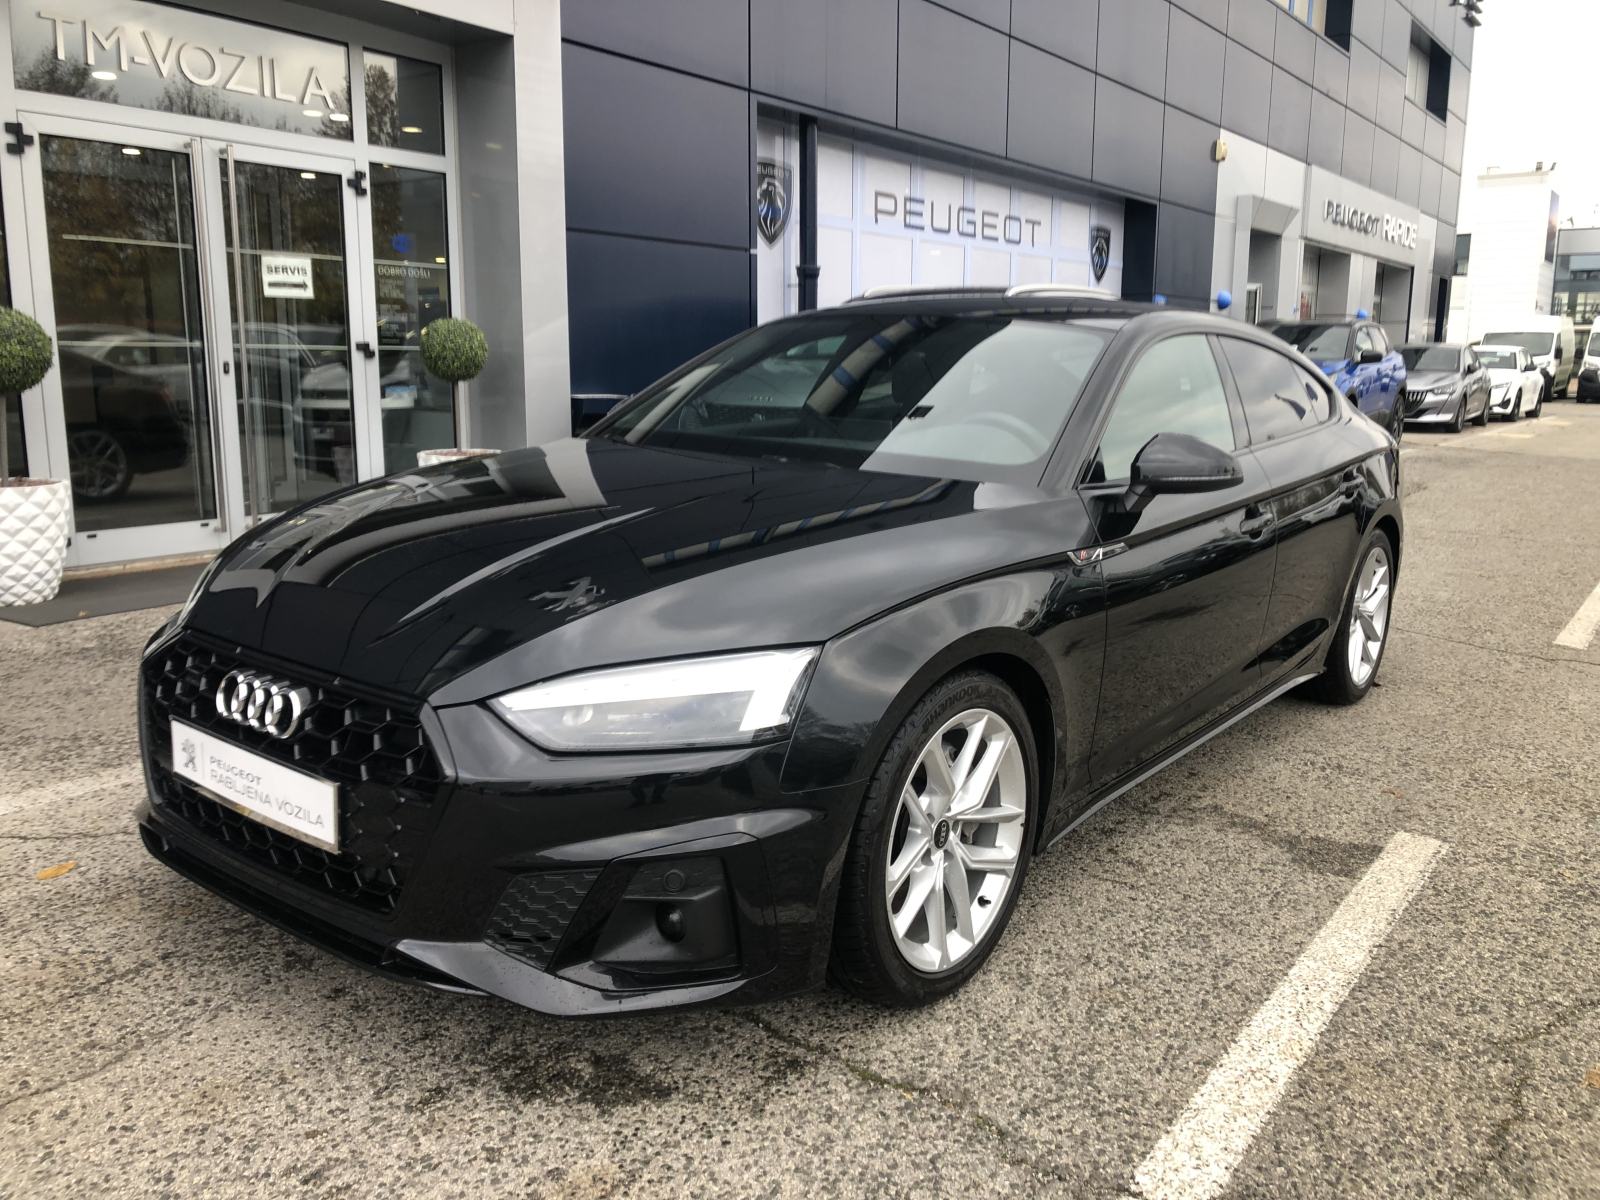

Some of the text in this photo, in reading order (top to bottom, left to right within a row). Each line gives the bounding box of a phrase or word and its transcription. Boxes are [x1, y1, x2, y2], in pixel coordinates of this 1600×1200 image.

[37, 10, 336, 110] TM-VOZILA
[874, 190, 1042, 248] PEUGEOT
[1324, 199, 1417, 249] PEUGEOT RAPIDE
[266, 264, 308, 277] SERVIS
[210, 756, 262, 785] PEUGEOT
[210, 769, 324, 827] RABLJENA VOZILA
